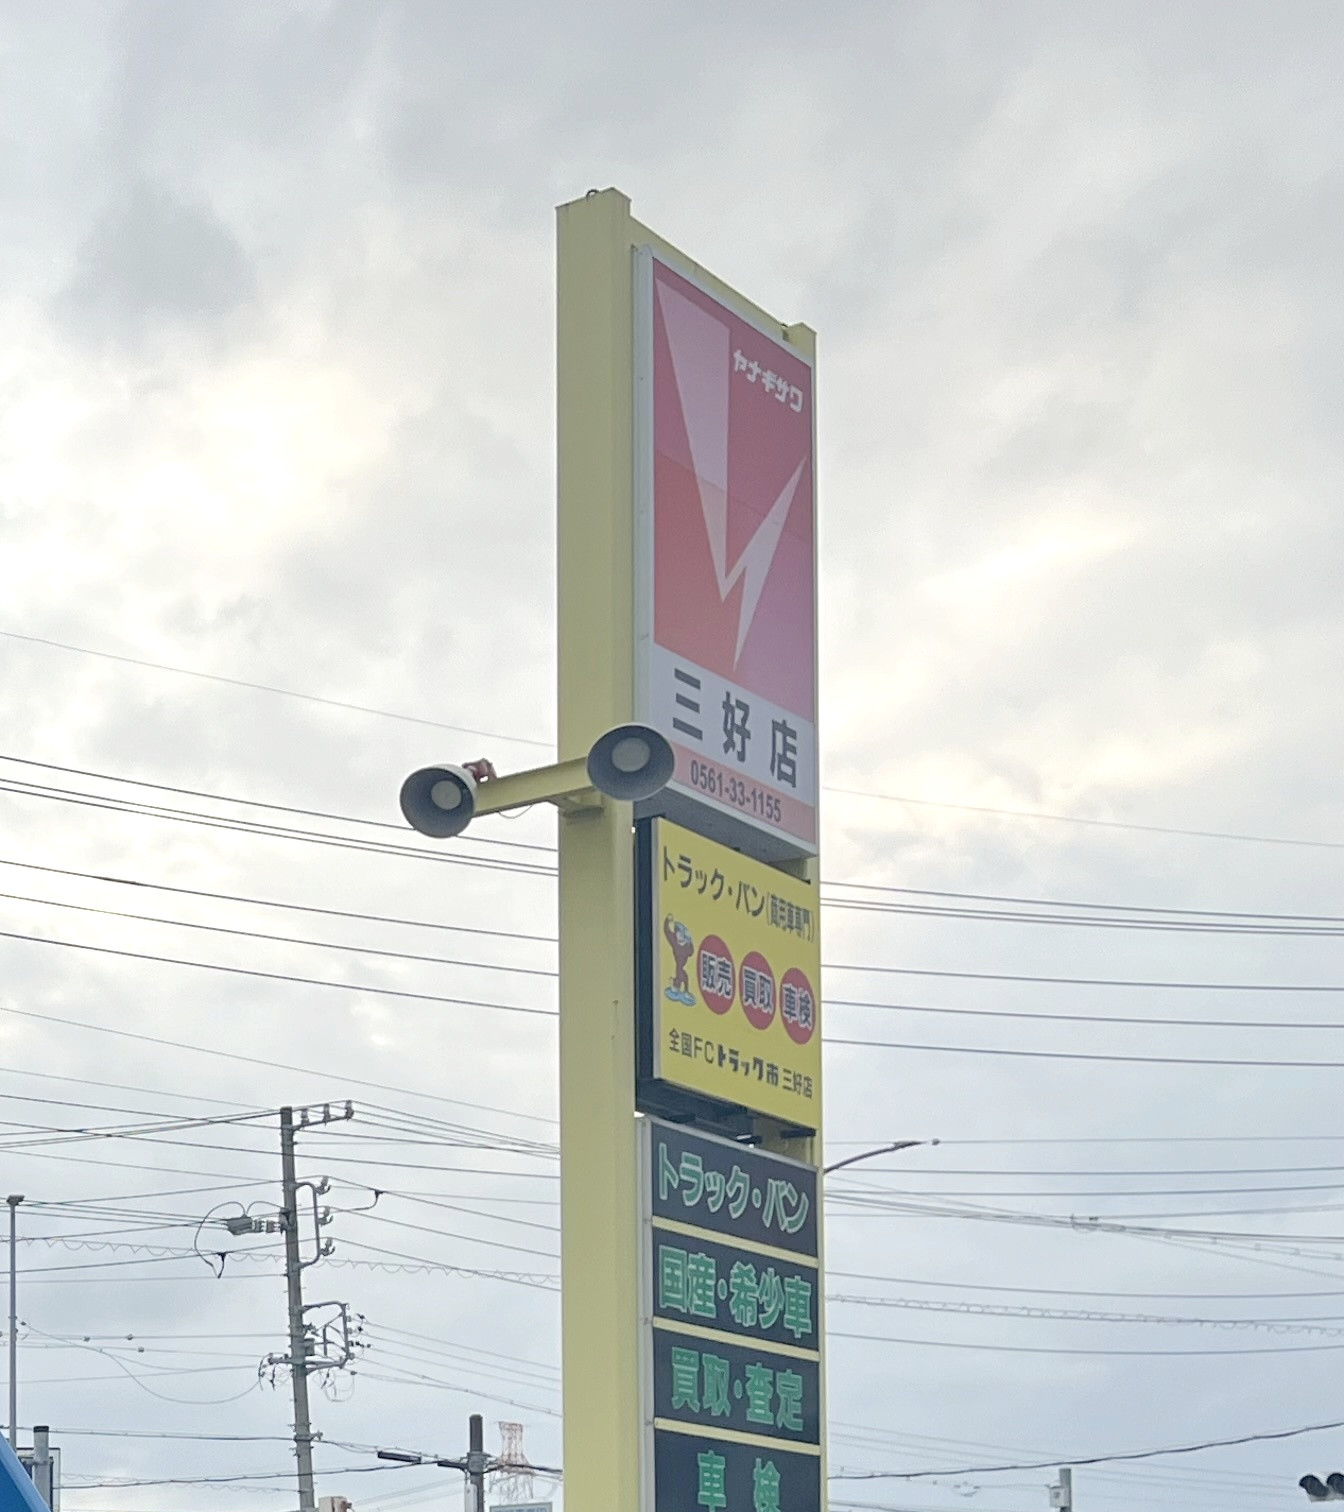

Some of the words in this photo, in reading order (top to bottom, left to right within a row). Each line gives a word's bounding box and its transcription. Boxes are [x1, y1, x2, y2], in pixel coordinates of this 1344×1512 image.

[733, 349, 803, 413] ヤナギサワ
[673, 668, 797, 788] 三好店
[690, 759, 782, 823] 0561-33-1155
[701, 950, 732, 999] 販売
[742, 965, 773, 1015] 買取
[782, 983, 812, 1031] 車検
[657, 1141, 810, 1235] トラック・バン
[659, 1244, 812, 1338] 国産・希少車
[671, 1346, 804, 1431] 買取・査定
